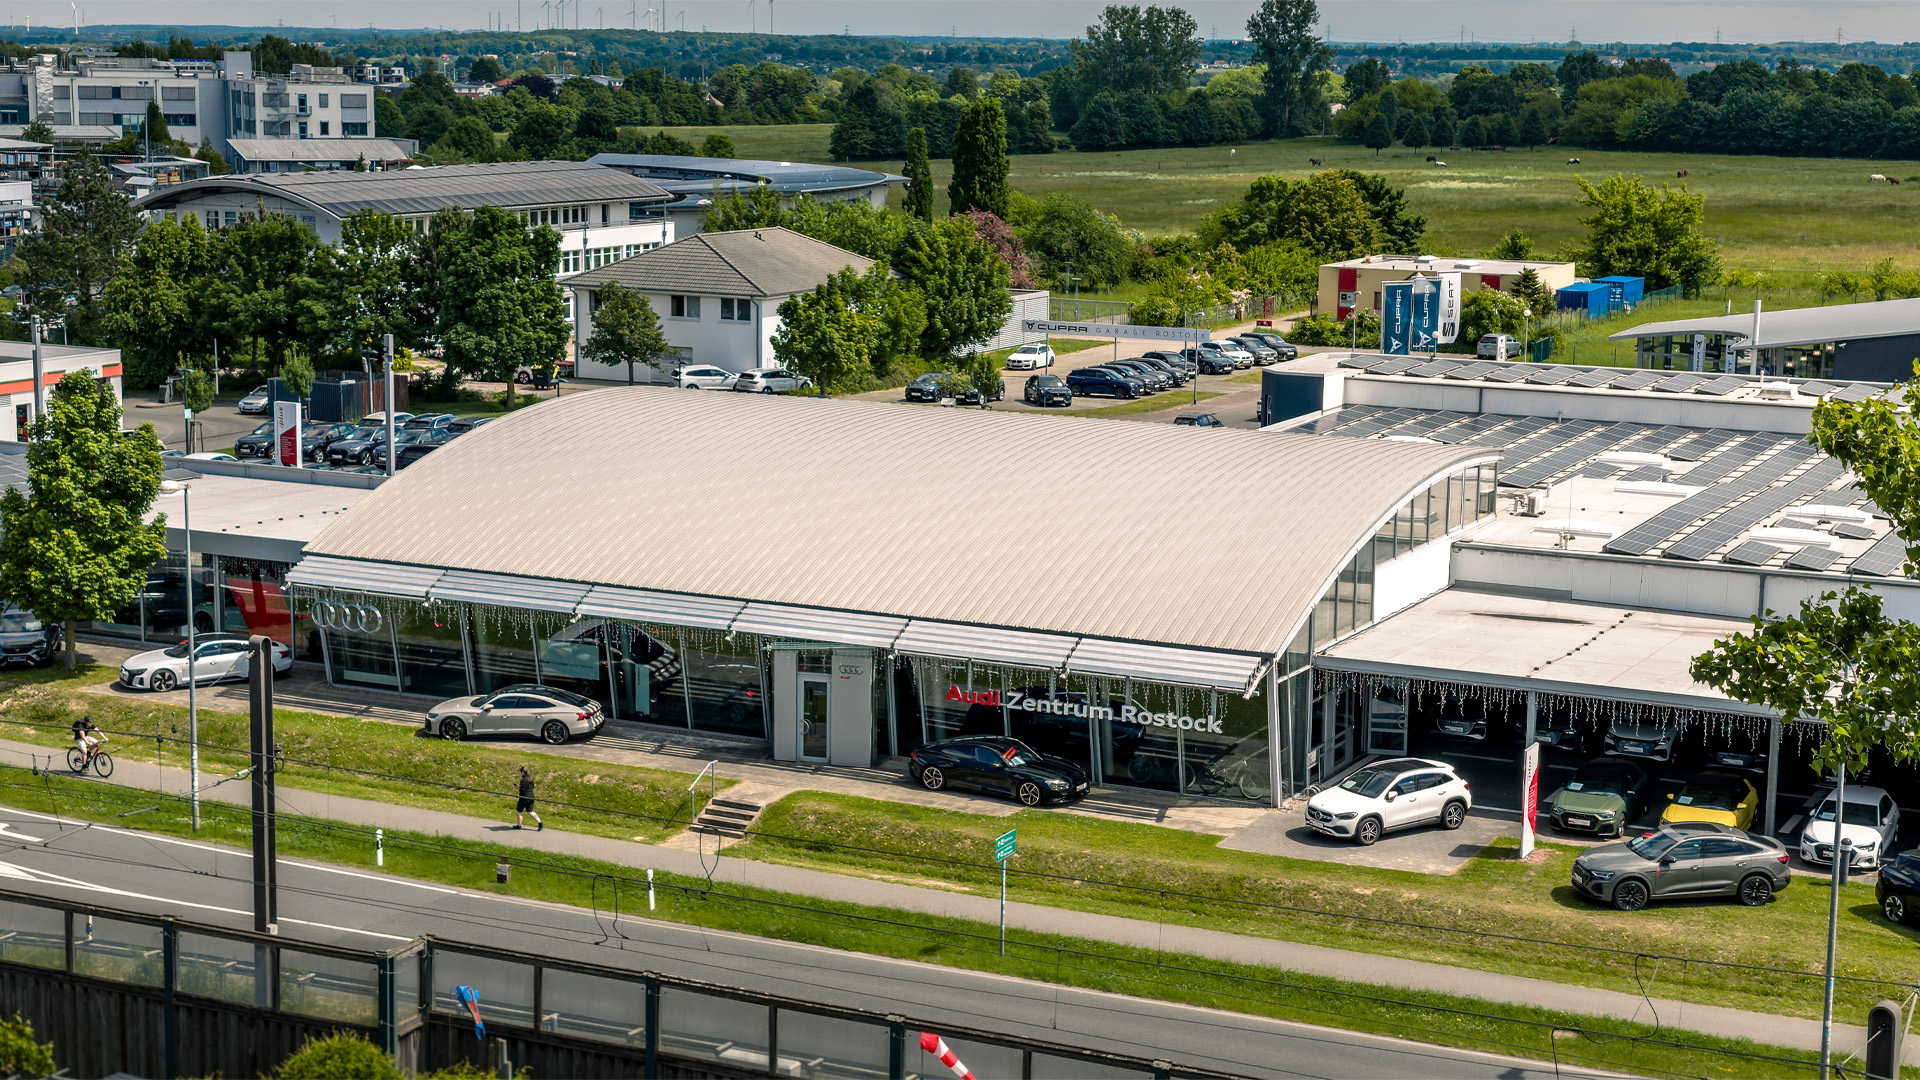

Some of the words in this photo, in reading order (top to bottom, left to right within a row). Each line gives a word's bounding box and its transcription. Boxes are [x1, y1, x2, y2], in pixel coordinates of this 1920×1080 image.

[1037, 323, 1088, 333] CUPRA
[1095, 327, 1147, 337] GARAGE
[1155, 330, 1206, 340] ROSTOCK
[945, 685, 1000, 707] Audi
[1007, 691, 1113, 720] Zentrum
[1121, 705, 1223, 734] Rostock
